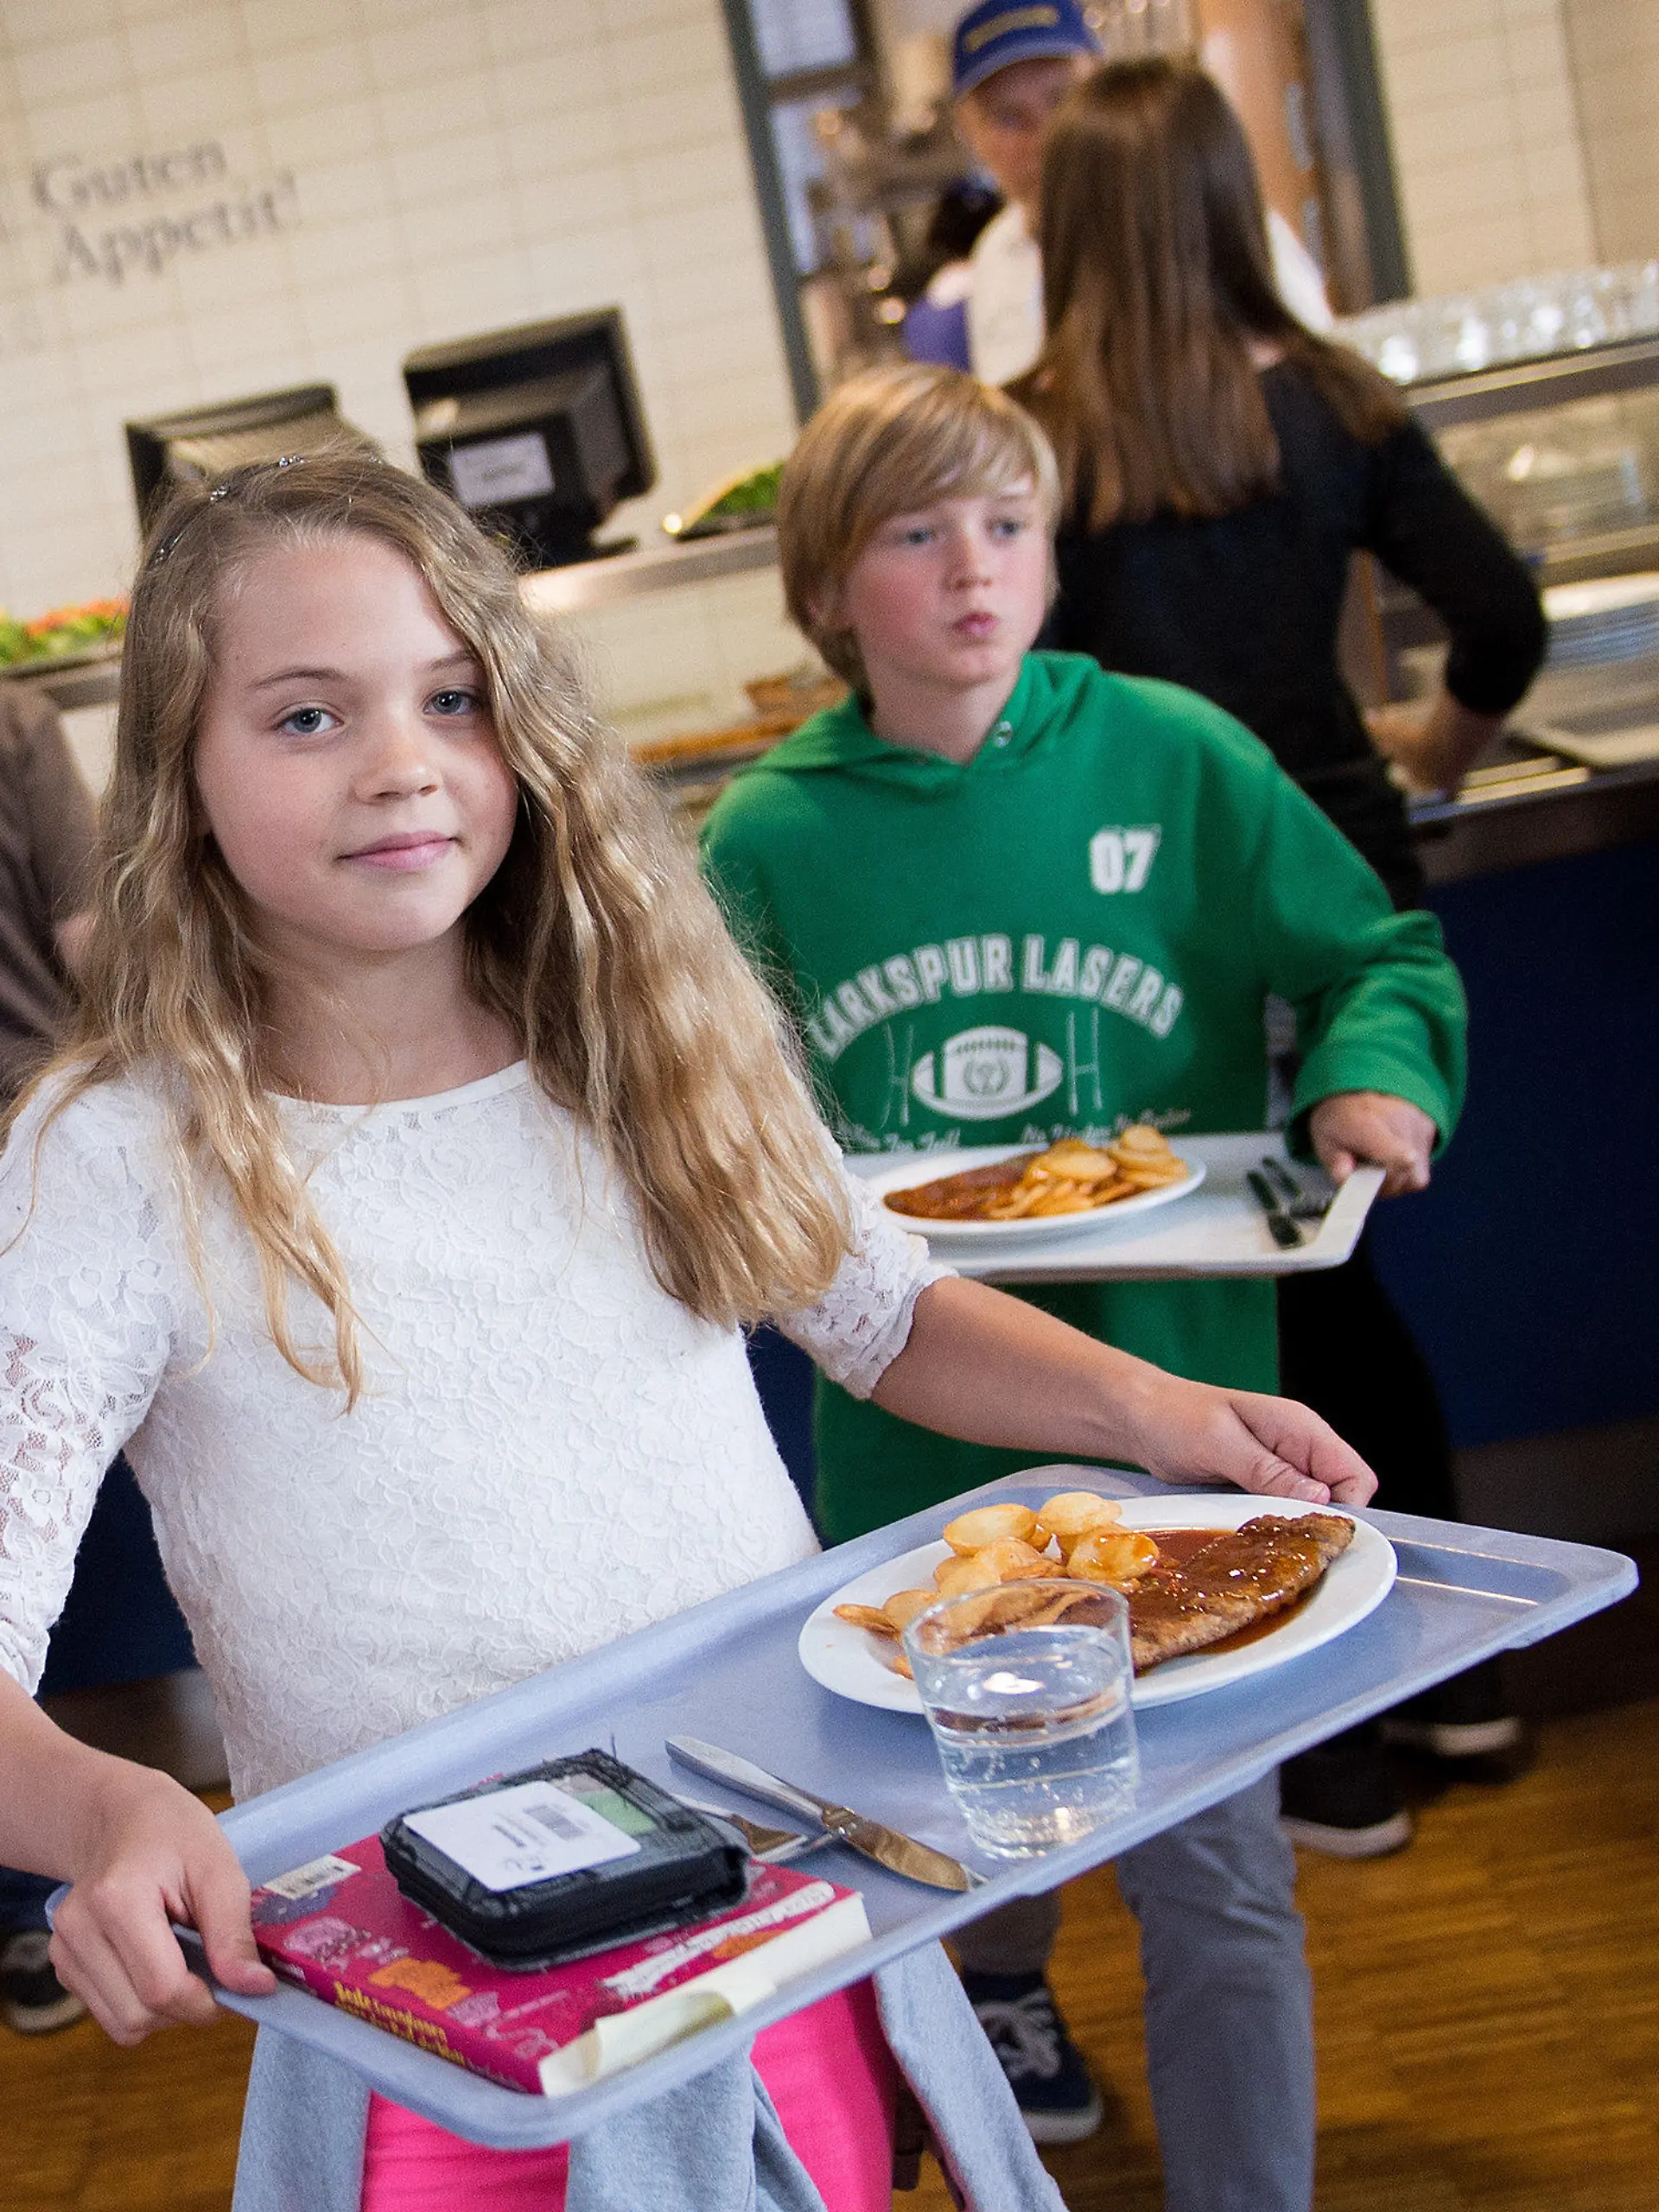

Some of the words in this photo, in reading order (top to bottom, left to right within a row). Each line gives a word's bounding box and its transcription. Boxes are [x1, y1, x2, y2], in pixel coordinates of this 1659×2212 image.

[32, 141, 226, 212] Guten
[1089, 823, 1163, 895] 07
[808, 932, 1014, 1063] LARKSPUR
[1020, 933, 1185, 1038] LASERS
